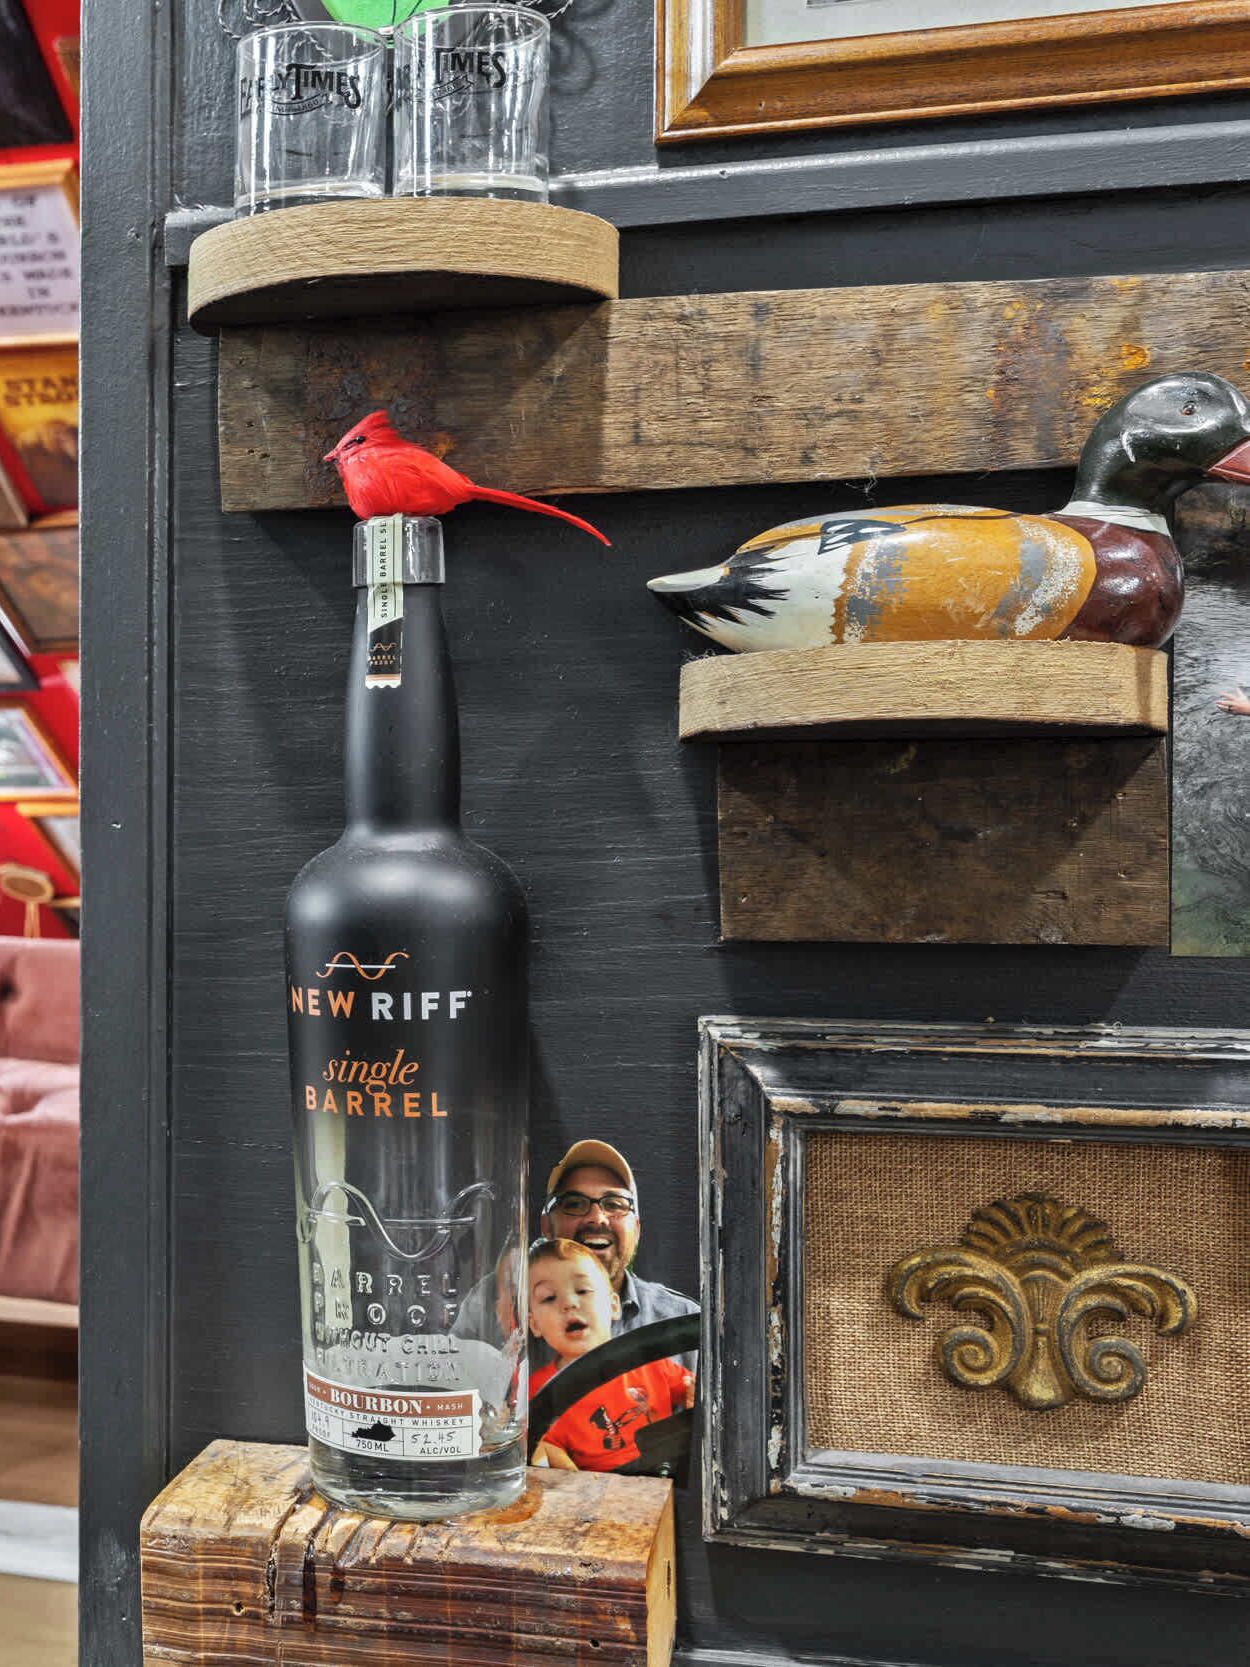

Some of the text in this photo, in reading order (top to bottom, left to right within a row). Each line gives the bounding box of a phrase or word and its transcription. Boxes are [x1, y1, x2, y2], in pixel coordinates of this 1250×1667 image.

[434, 47, 507, 89] TIMES
[286, 63, 361, 110] TIMES
[379, 538, 388, 577] BARREL
[381, 582, 389, 618] SINGLE
[291, 984, 468, 1021] NEW RIFF
[321, 1049, 420, 1097] single
[305, 1085, 448, 1119] BARREL
[312, 1261, 459, 1298] BARREL
[329, 1388, 423, 1415] BOURBON
[437, 1402, 463, 1412] MASH
[349, 1412, 405, 1426] STRAIGHT
[411, 1417, 465, 1427] WHISKEY
[355, 1438, 390, 1453] 750 ML
[419, 1446, 462, 1455] ALC/VOL
